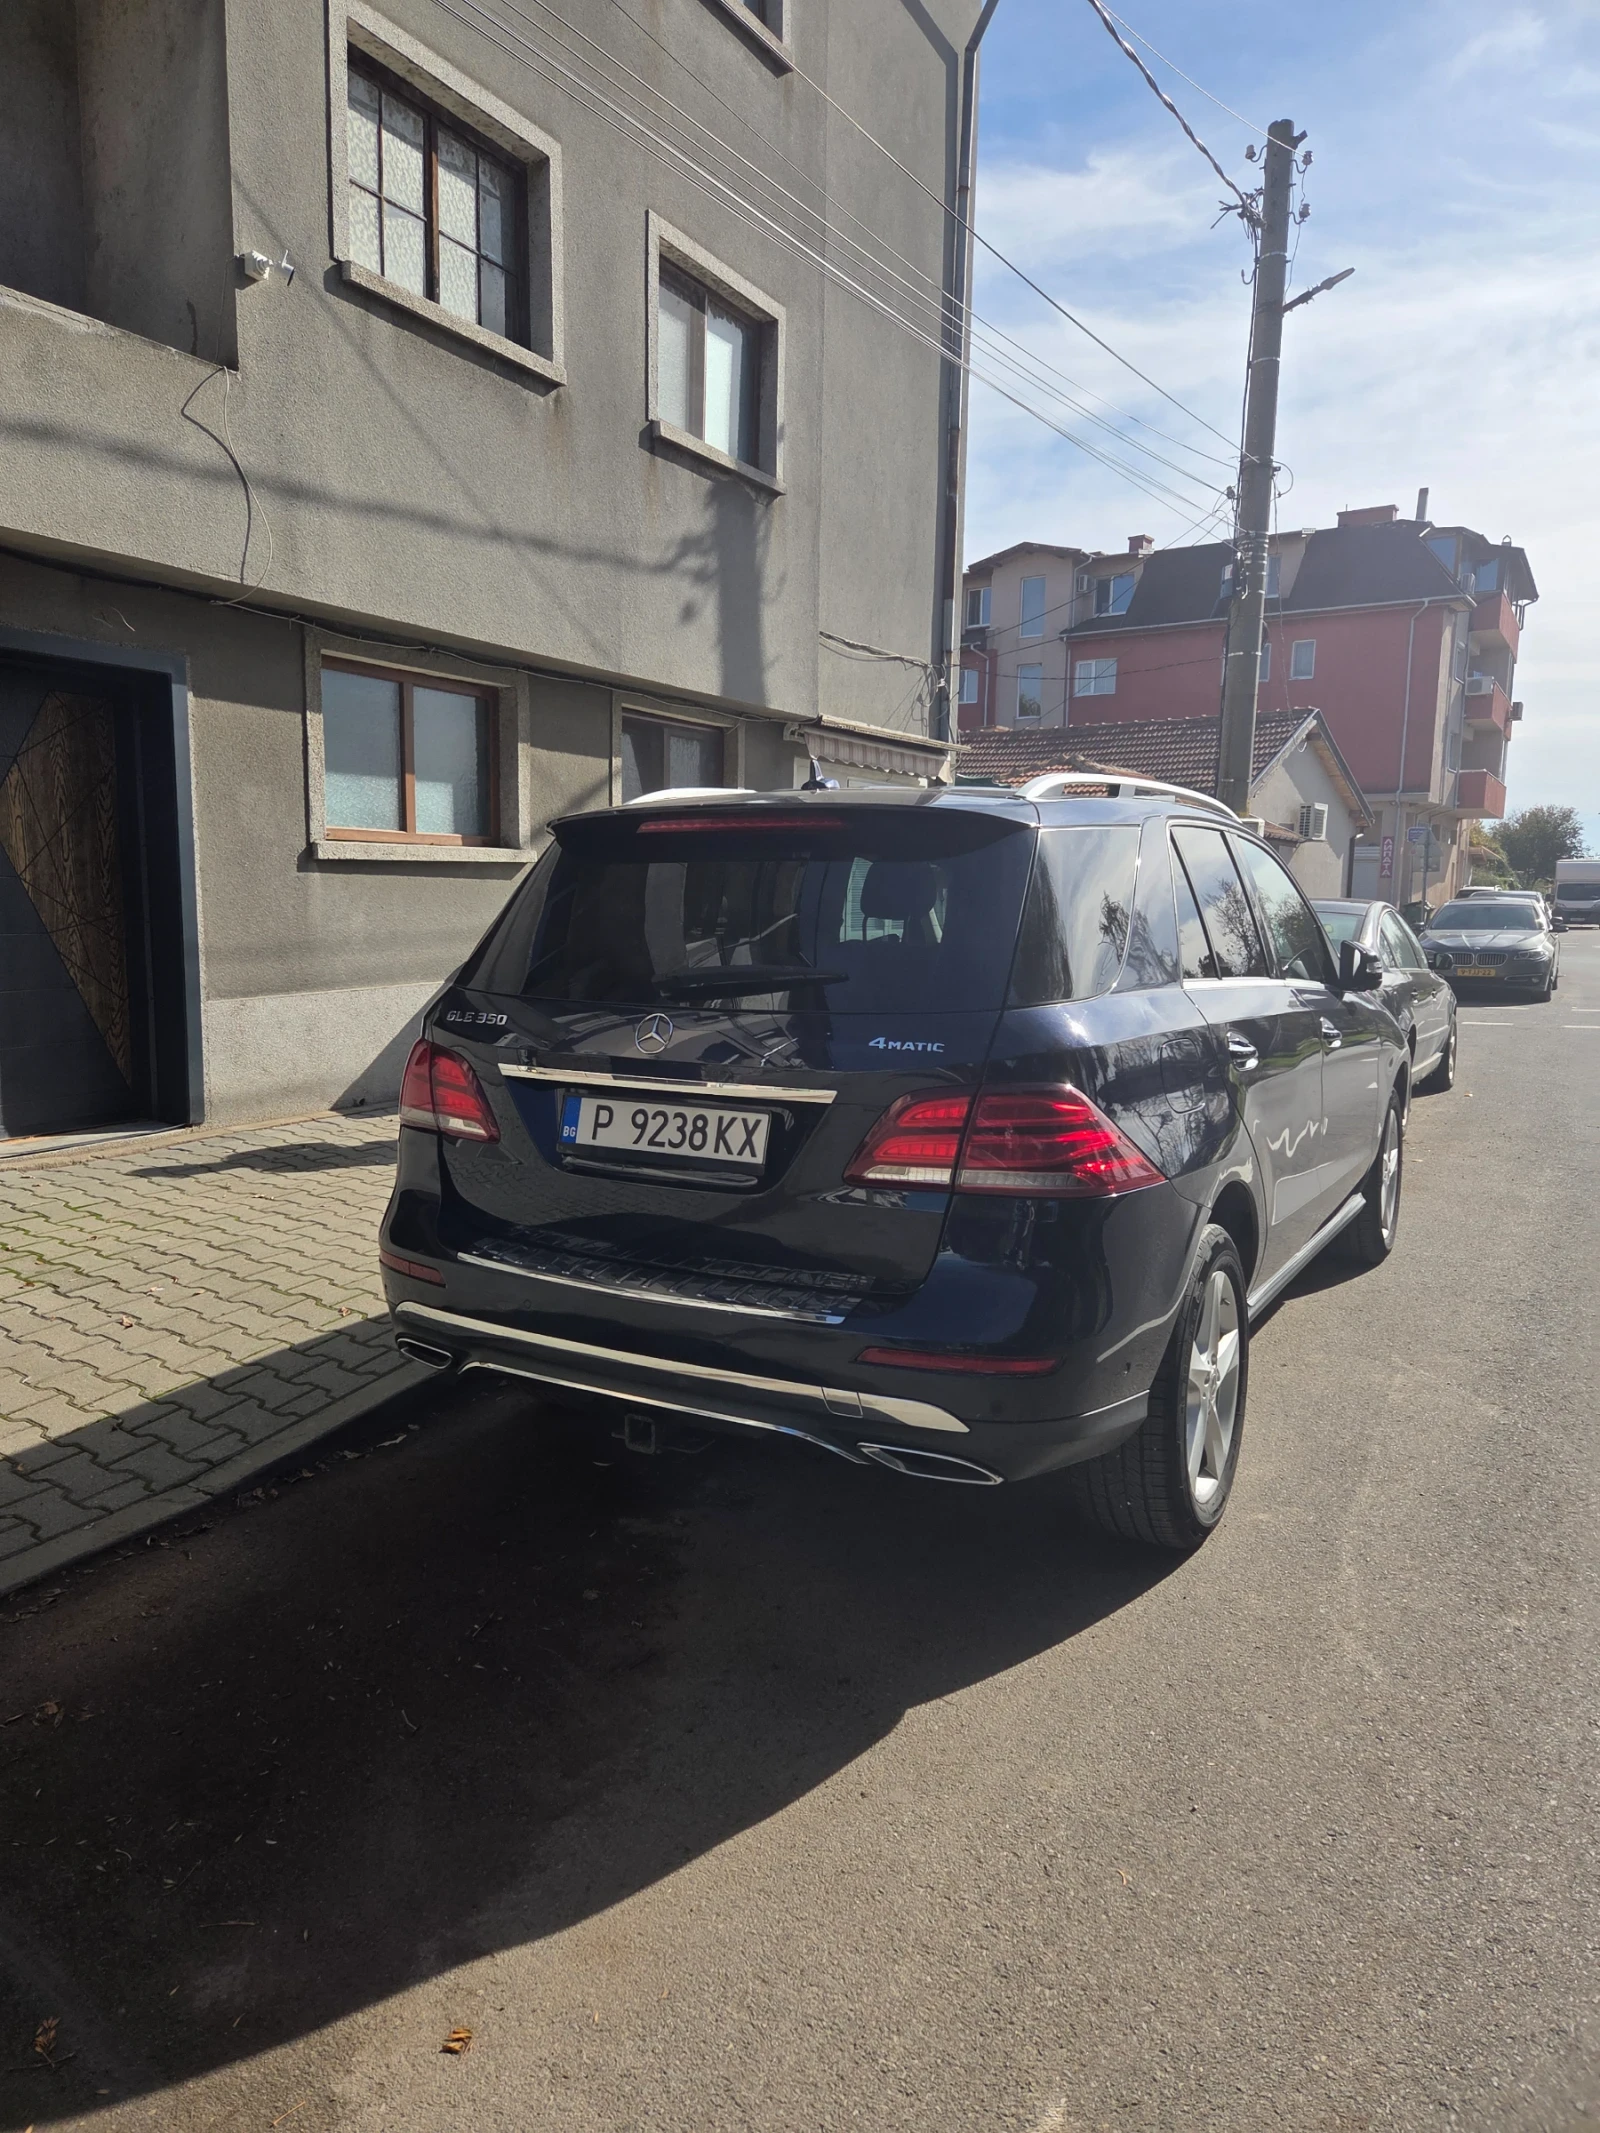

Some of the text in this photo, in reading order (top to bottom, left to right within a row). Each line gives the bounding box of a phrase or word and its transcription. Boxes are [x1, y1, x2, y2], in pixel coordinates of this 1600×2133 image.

[1381, 838, 1393, 876] ЛИПАТА
[446, 1010, 508, 1026] GLE 350
[868, 1036, 945, 1053] 4MATIC
[562, 1125, 576, 1137] BG
